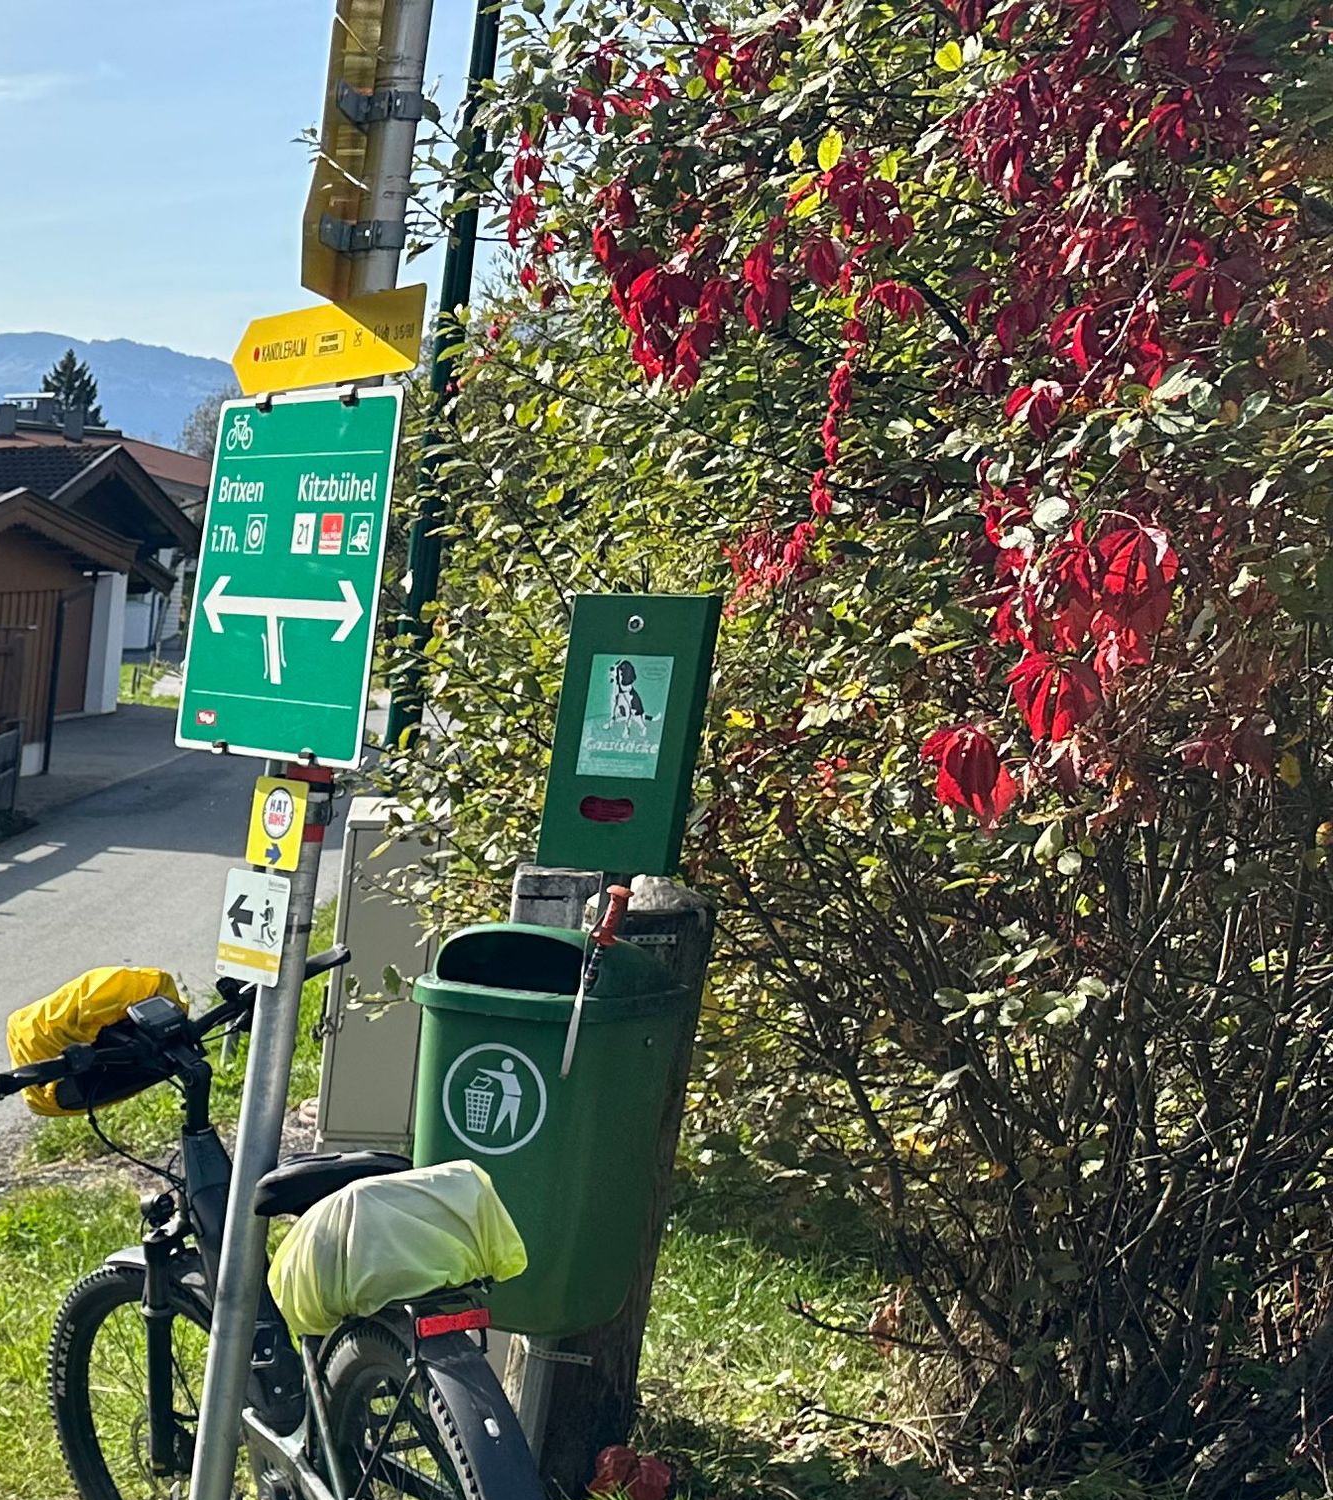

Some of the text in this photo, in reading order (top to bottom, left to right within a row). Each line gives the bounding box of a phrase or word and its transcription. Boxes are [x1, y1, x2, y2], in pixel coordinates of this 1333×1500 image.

[218, 475, 265, 503] Brixen
[297, 472, 378, 503] Kitzbühel
[211, 523, 239, 554] i.Th.
[296, 523, 311, 546] 21
[269, 798, 289, 814] HAT
[56, 1321, 76, 1398] MAXXIS
